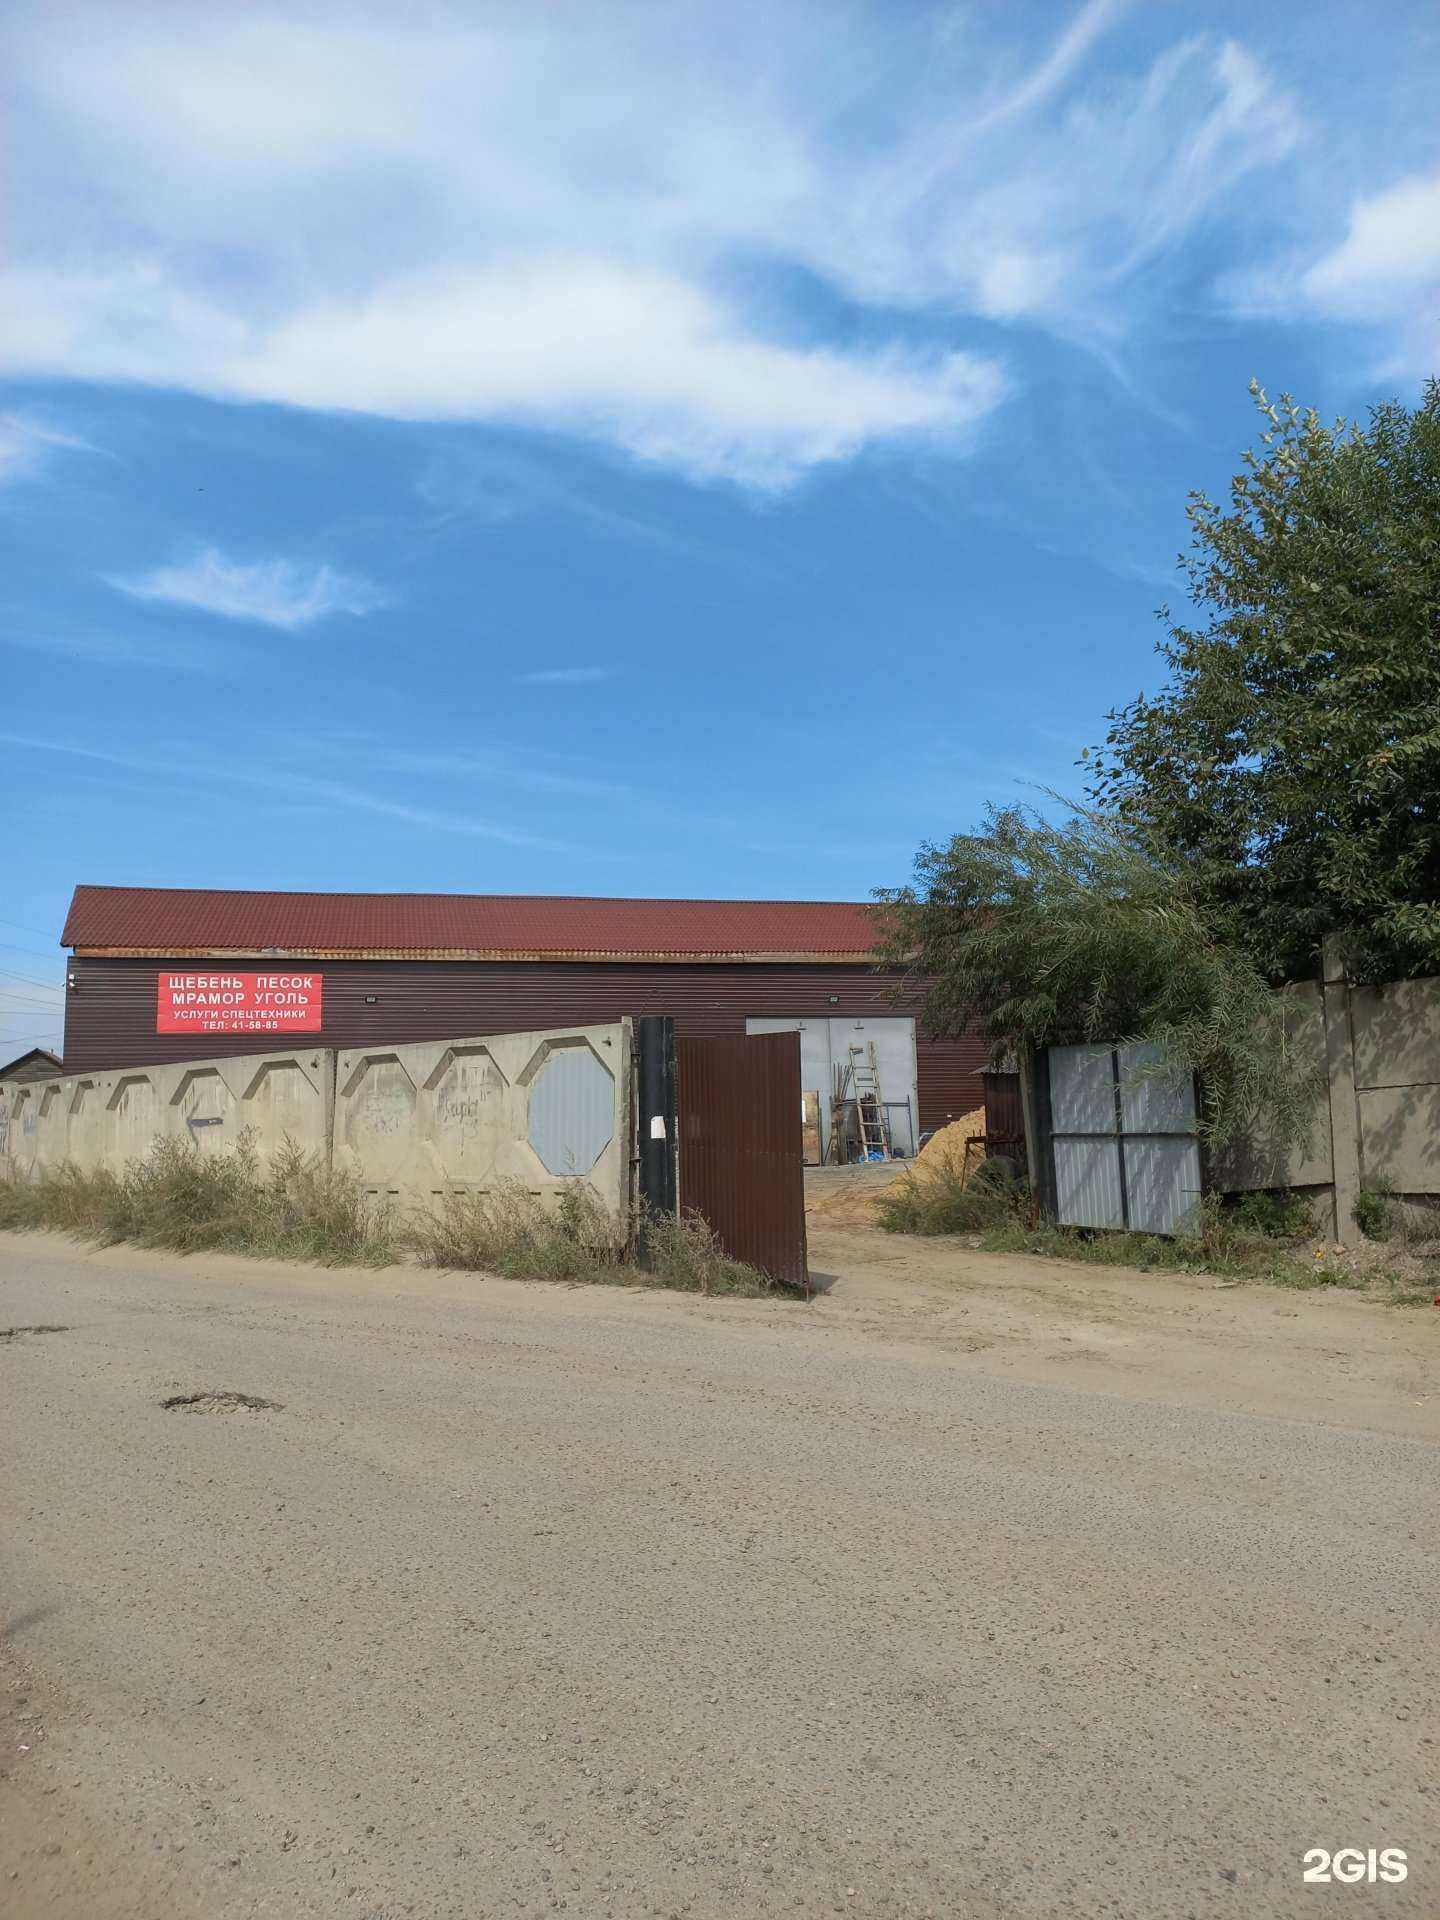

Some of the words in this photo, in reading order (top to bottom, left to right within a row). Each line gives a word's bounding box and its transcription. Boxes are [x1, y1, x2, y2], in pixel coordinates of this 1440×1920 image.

[169, 977, 243, 989] ЩЕБЕНЬ
[257, 977, 312, 988] ПЕСОК
[172, 993, 245, 1004] МРАМОР
[255, 993, 308, 1004] УГОЛЬ
[174, 1010, 218, 1019] УСЛУГИ
[222, 1010, 305, 1018] СПЕЦТЕХНИКИ
[202, 1021, 228, 1029] ТЕЛ:
